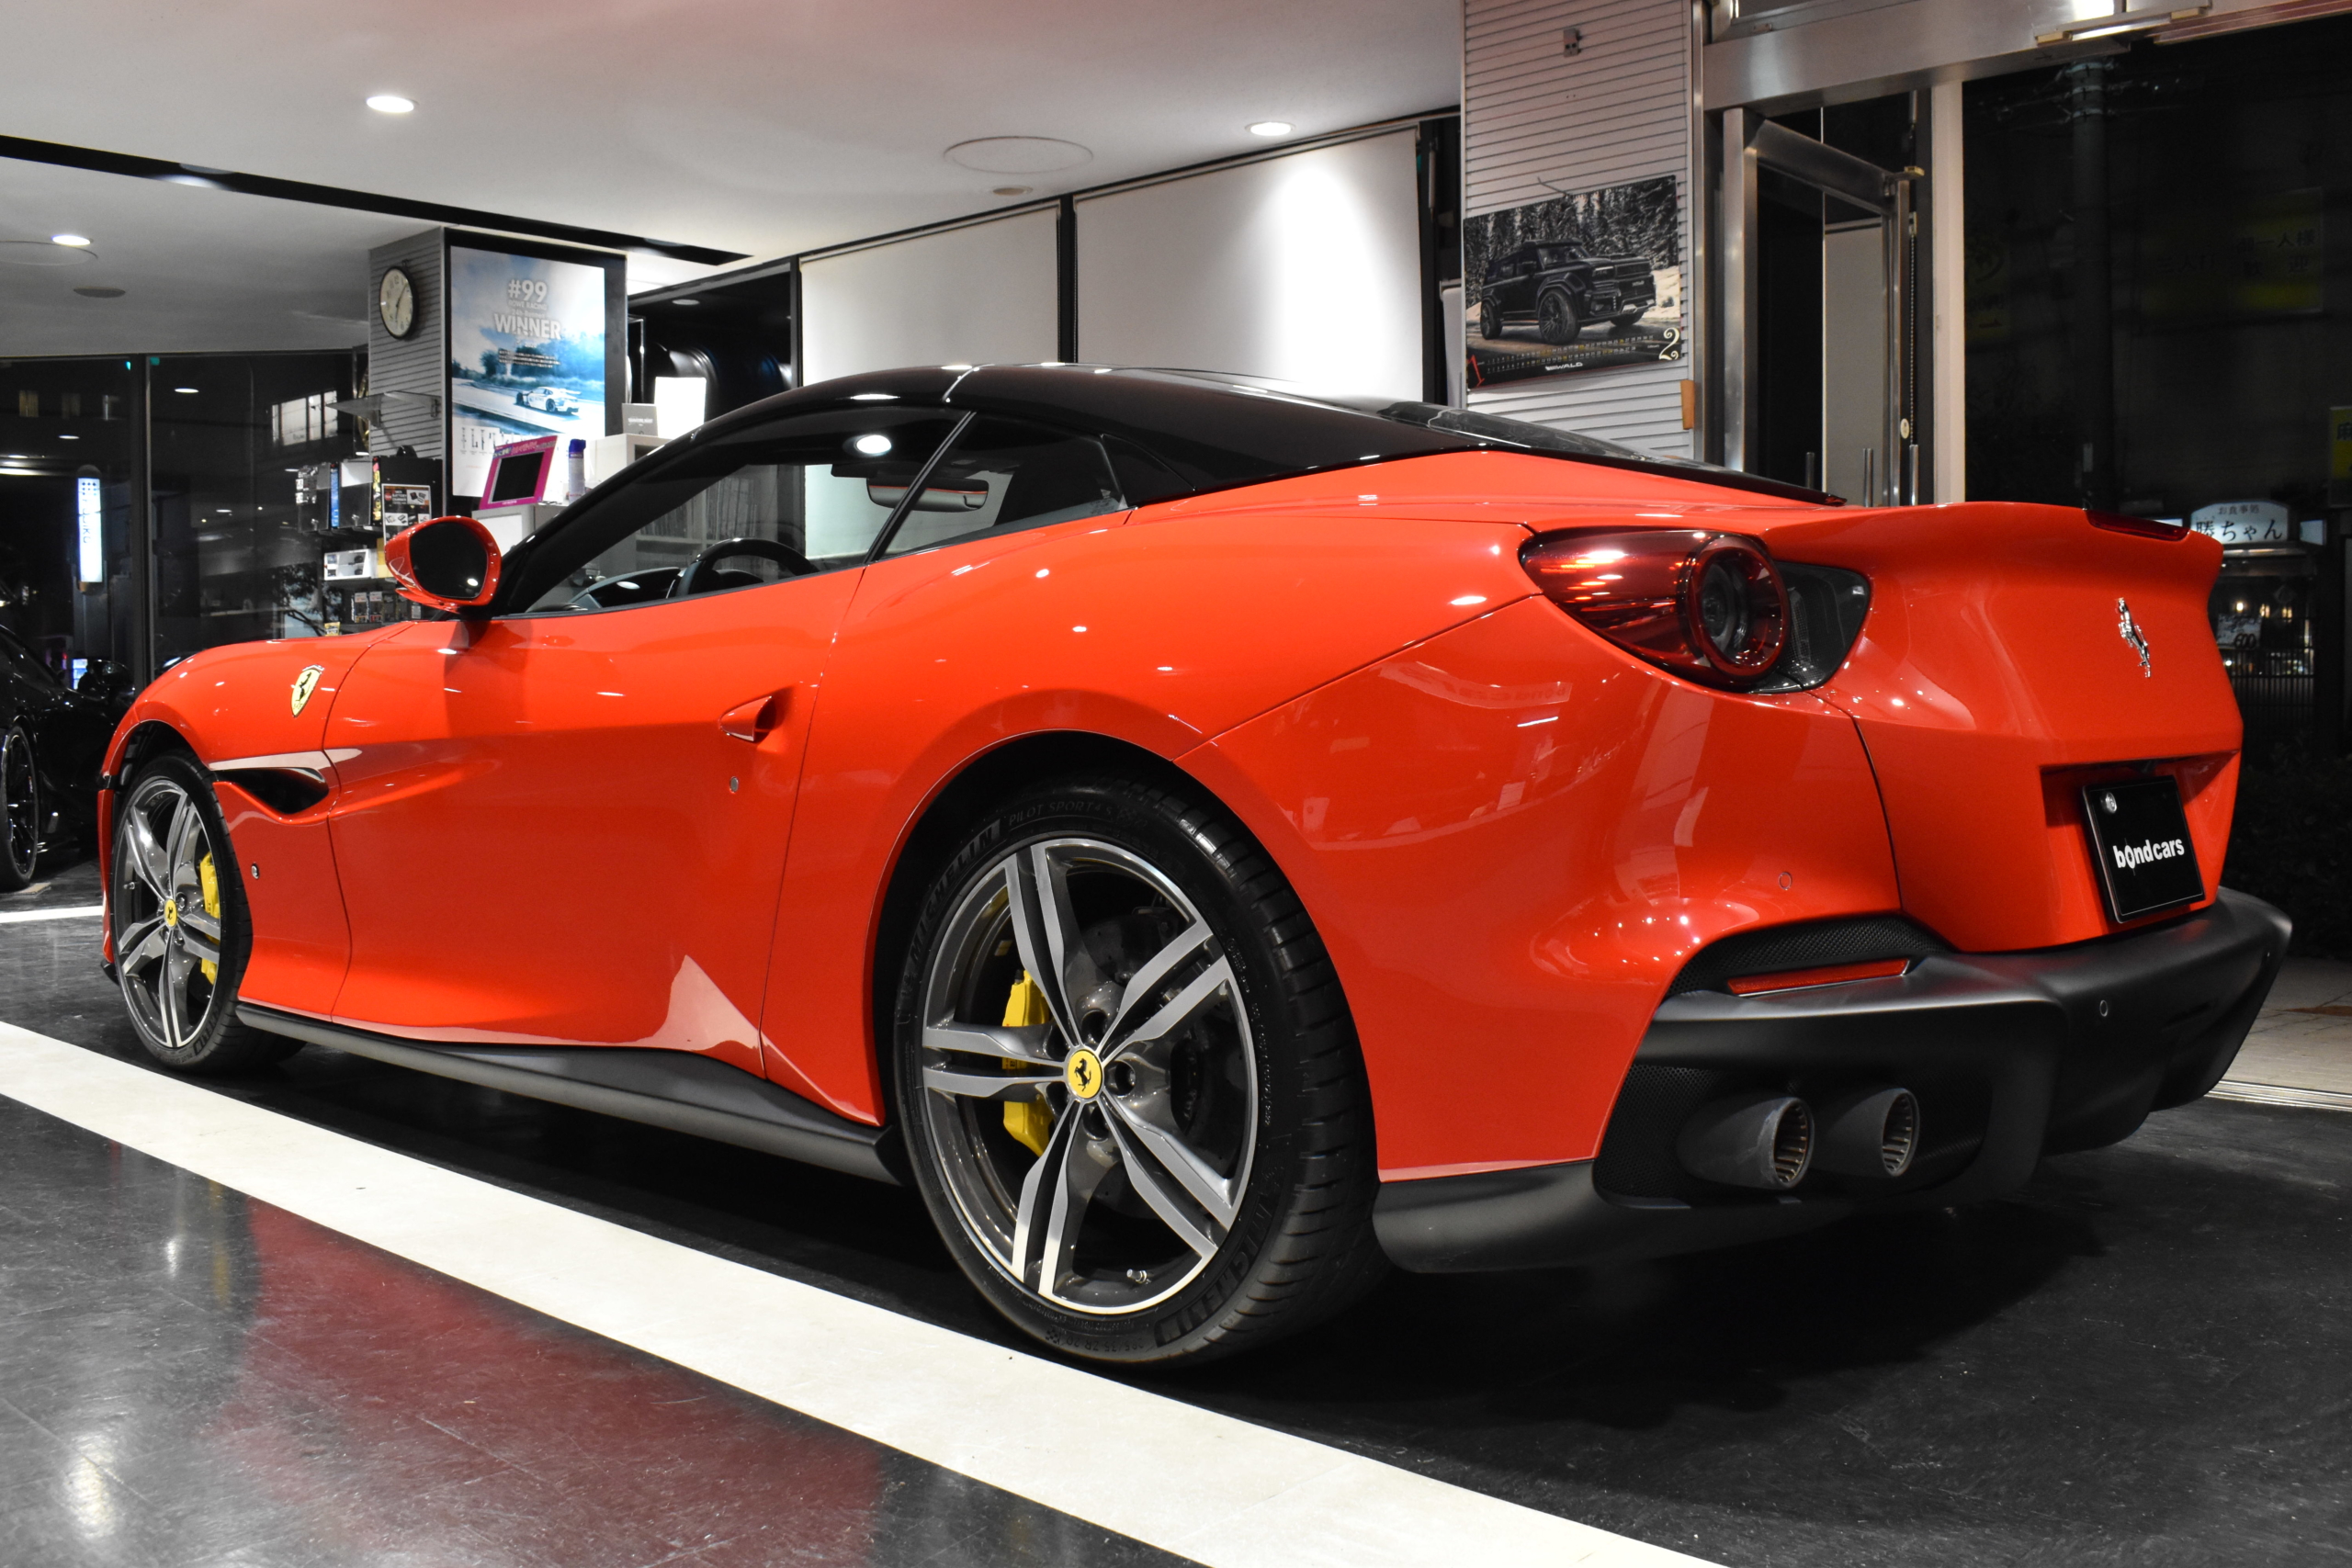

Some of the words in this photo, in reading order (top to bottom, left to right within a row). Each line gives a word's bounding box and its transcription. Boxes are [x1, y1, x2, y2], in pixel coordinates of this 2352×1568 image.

[508, 279, 548, 303] #99
[493, 313, 562, 340] WINNER
[1009, 804, 1044, 825] PILOT
[1049, 800, 1093, 812] SPORT
[2113, 839, 2185, 869] bondcars
[910, 824, 995, 964] MICHELIN
[1158, 1196, 1274, 1348] MICHELIN
